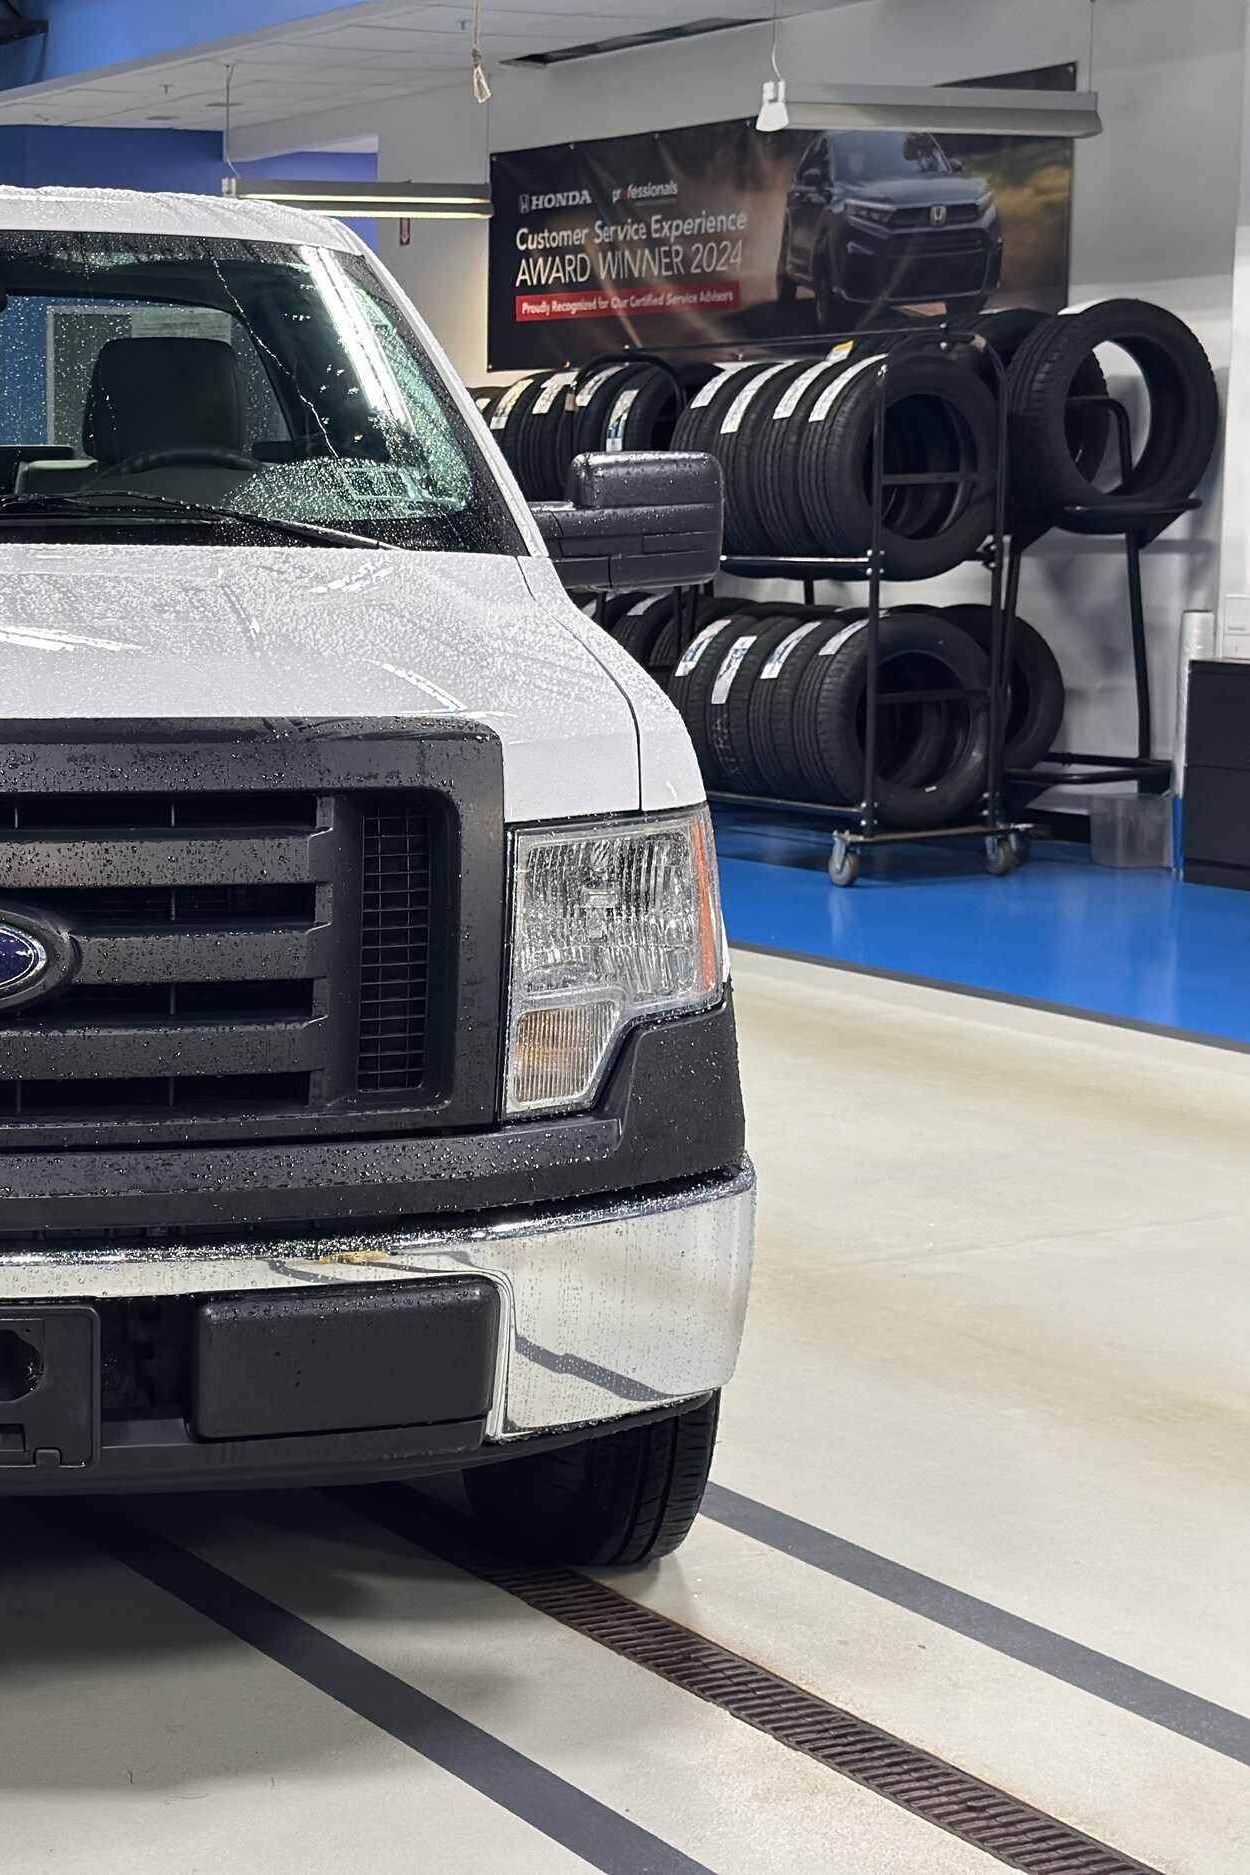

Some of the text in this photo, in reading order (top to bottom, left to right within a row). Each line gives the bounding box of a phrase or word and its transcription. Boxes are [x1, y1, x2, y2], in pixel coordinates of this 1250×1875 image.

[531, 189, 592, 210] HONDA
[516, 210, 748, 251] Customer Service Experience
[515, 239, 743, 288] AWARD WINNER 2024
[521, 288, 734, 316] Proudly Recognized for Our Certified Service Advisors
